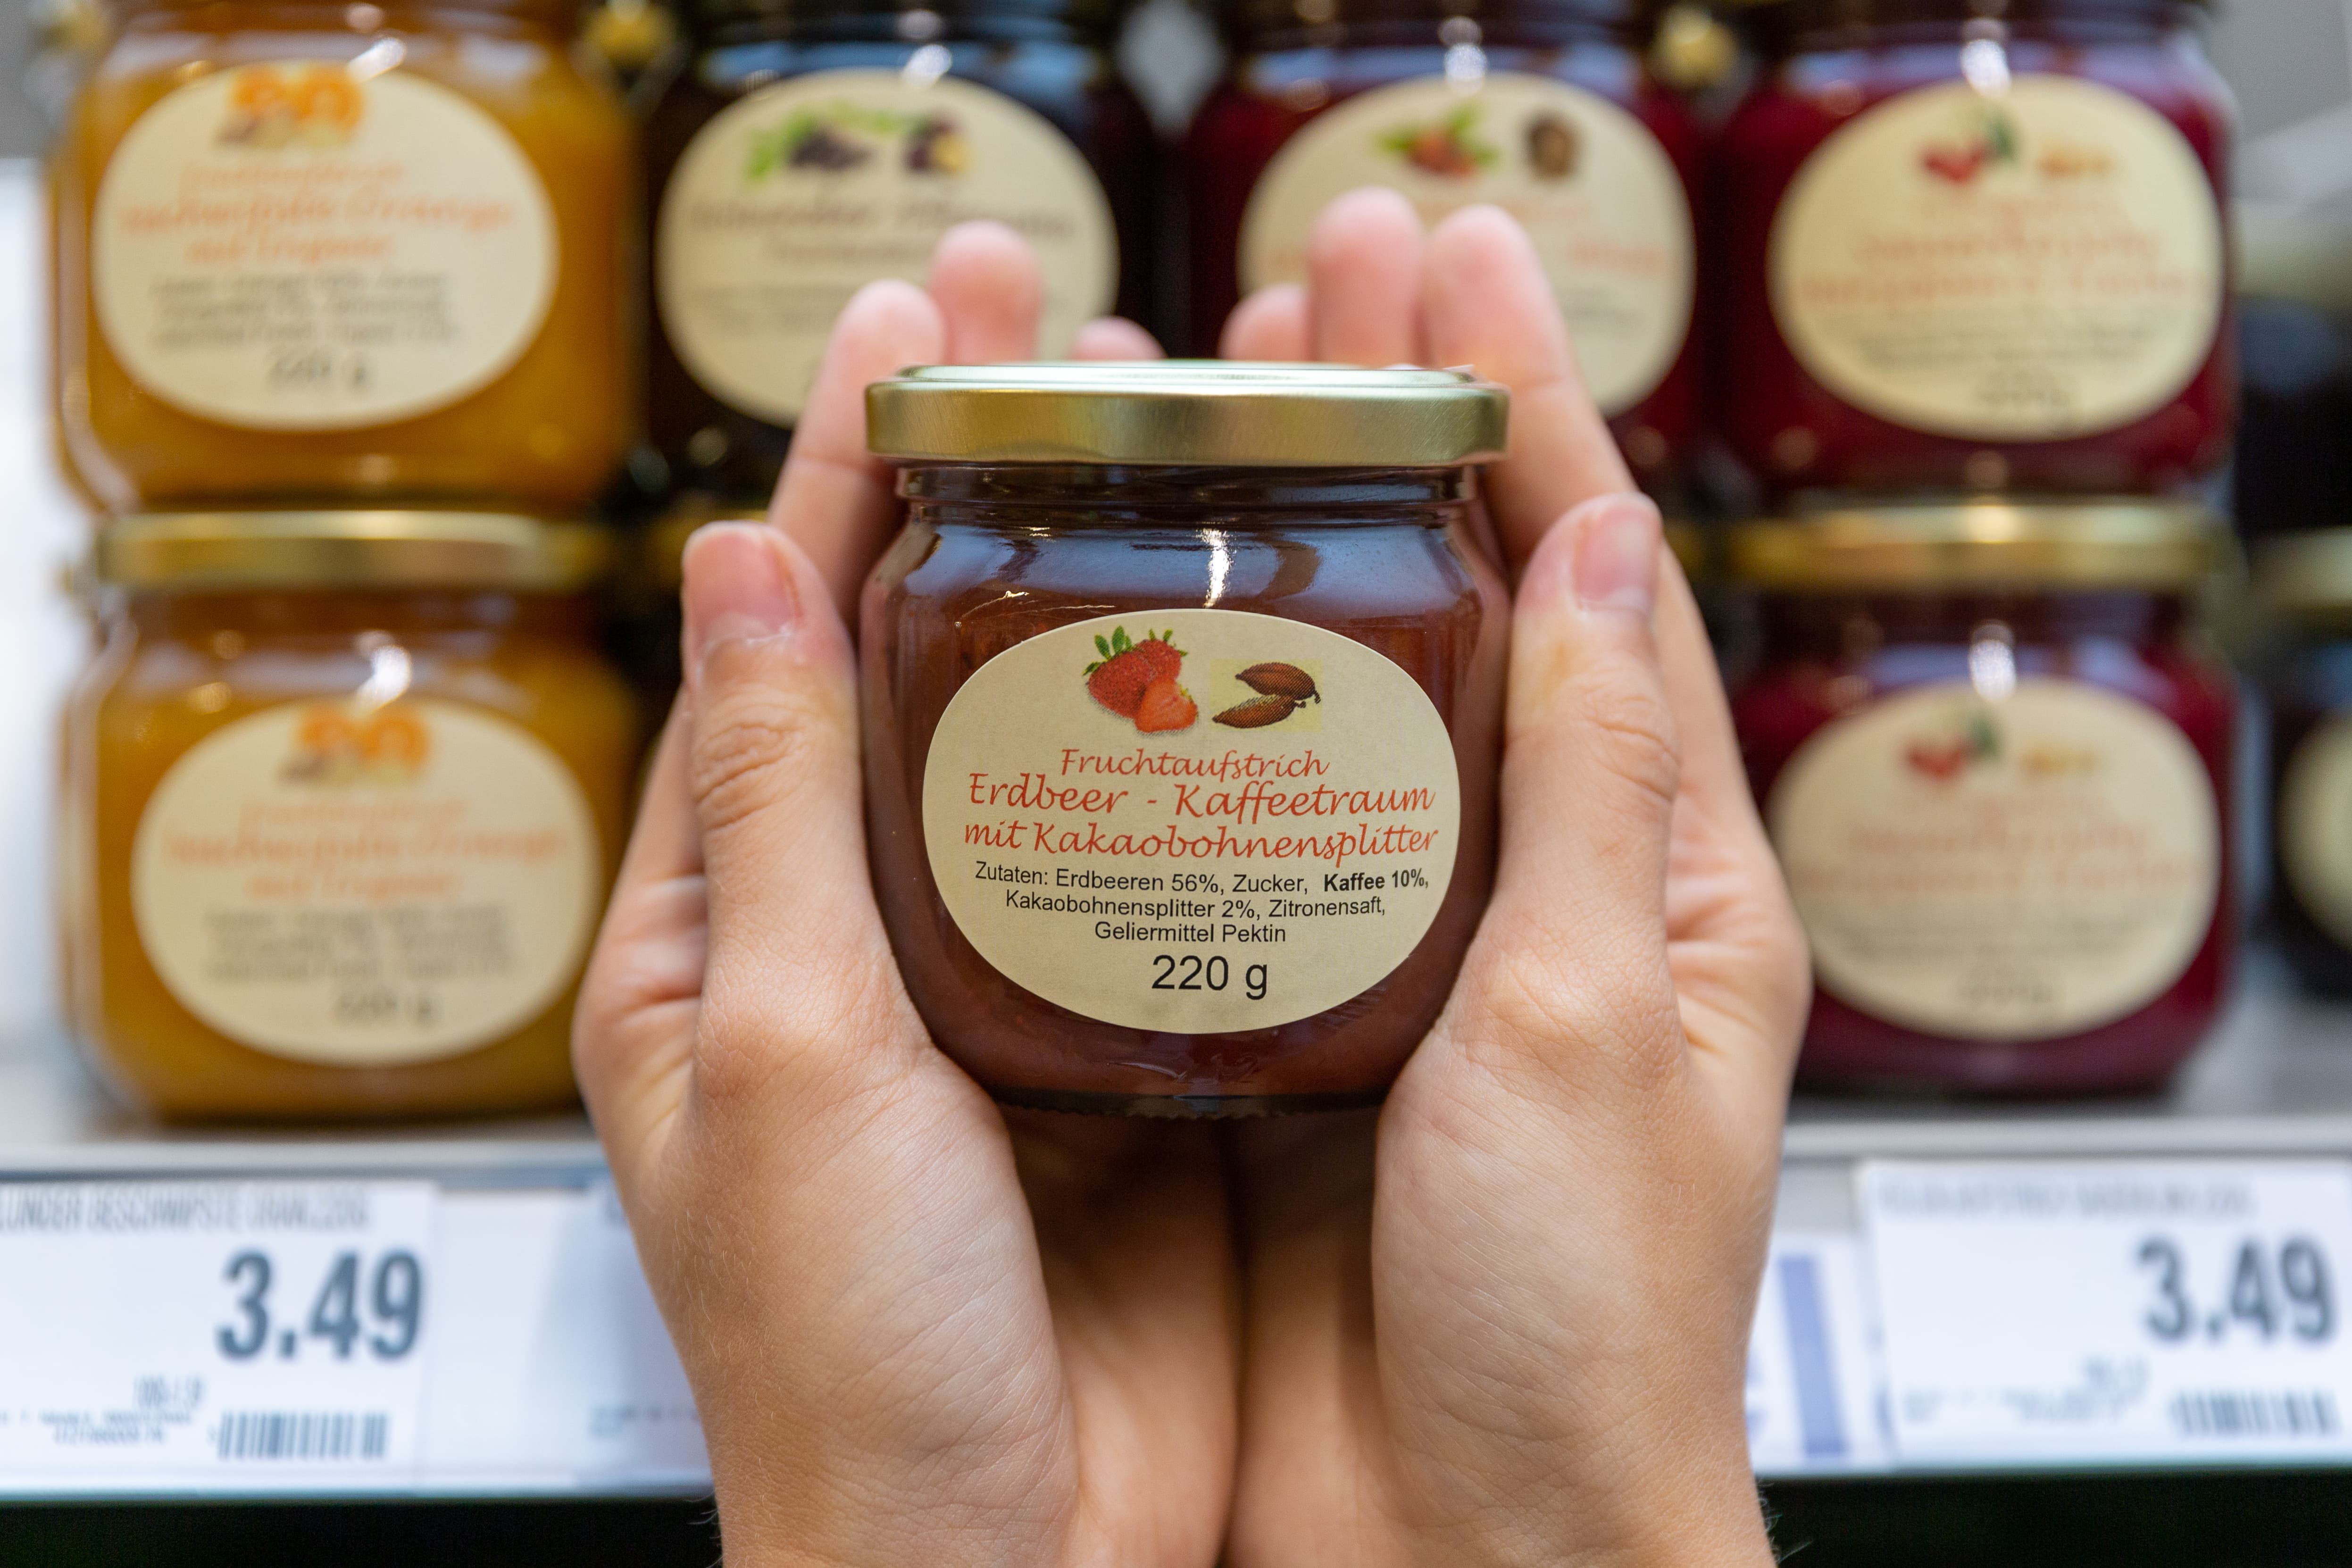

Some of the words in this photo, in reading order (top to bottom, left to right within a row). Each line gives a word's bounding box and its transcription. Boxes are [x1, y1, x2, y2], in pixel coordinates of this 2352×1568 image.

[1061, 748, 1331, 783] Fruchtaufstrich
[969, 772, 1128, 814] Erdbeer
[1174, 780, 1436, 825] Kaffeetraum
[964, 820, 1028, 850] mit
[1033, 822, 1439, 869] Kakaobohnensplitter
[975, 860, 1048, 886] Zutaten:
[1056, 867, 1164, 892] Erdbeeren
[1171, 873, 1225, 896] 56%,
[1232, 873, 1308, 895] Zucker,
[1324, 871, 1386, 892] Kaffee
[1391, 867, 1429, 889] 10%,
[1006, 888, 1216, 921] Kakaobohnensplitter
[1221, 899, 1260, 921] 2%,
[1268, 895, 1386, 918] Zitronensaft,
[1094, 920, 1215, 943] Geliermittel
[1222, 923, 1286, 943] Pektin
[1151, 954, 1229, 992] 220
[1245, 963, 1268, 1001] g
[216, 1247, 424, 1362] 3.49
[2136, 1236, 2338, 1343] 3.49
